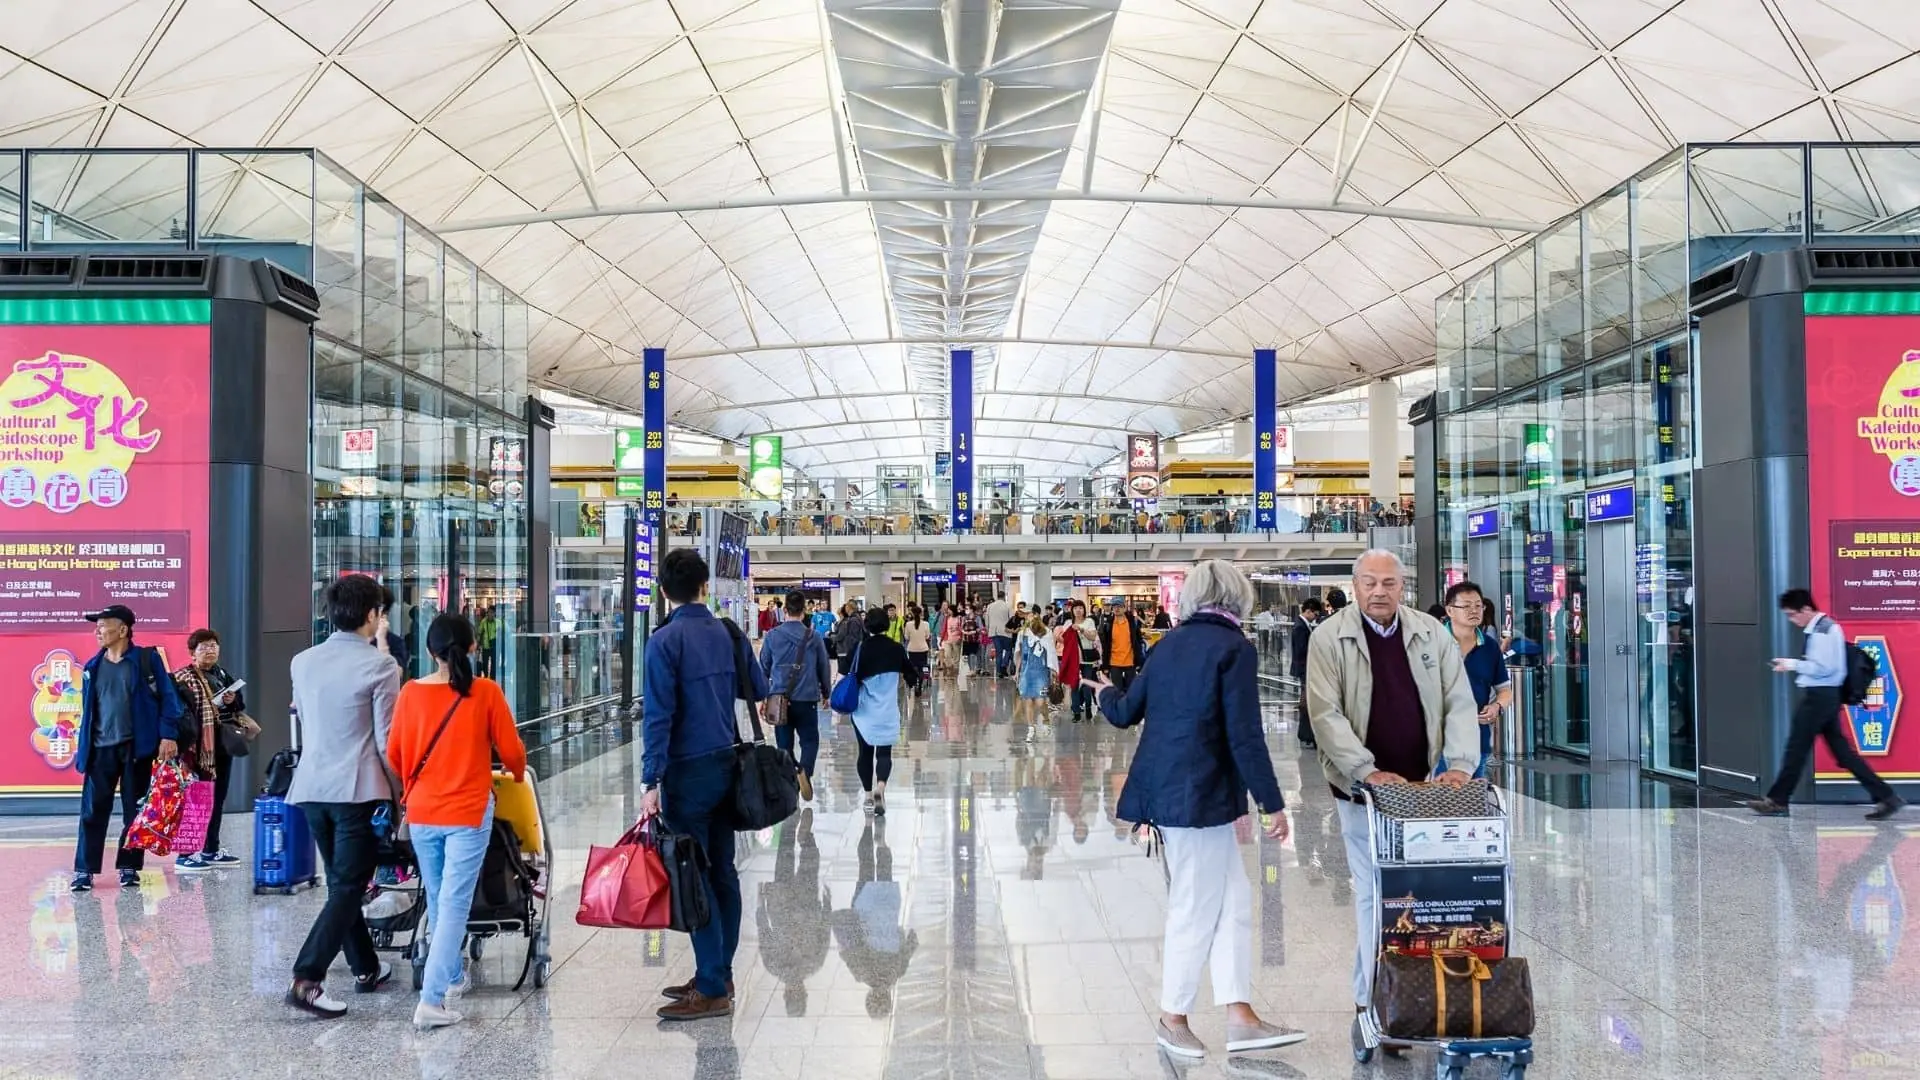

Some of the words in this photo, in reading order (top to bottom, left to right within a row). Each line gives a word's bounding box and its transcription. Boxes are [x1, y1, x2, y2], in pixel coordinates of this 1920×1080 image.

[649, 371, 660, 379] 40
[10, 352, 161, 452] 文化
[0, 414, 56, 428] ultural
[648, 431, 662, 440] 201
[1260, 432, 1271, 440] 40
[646, 441, 662, 449] 230
[647, 491, 662, 499] 501
[957, 492, 968, 500] 15
[1258, 492, 1273, 500] 201
[1257, 501, 1274, 509] 230
[1838, 547, 1902, 559] Experience
[7, 559, 37, 570] Hong
[38, 559, 69, 570] Kong
[69, 558, 120, 570] Heritage
[122, 559, 136, 568] at
[136, 558, 164, 568] Gate
[166, 558, 182, 568] 30
[56, 590, 81, 598] Holiday
[47, 738, 71, 760] 車
